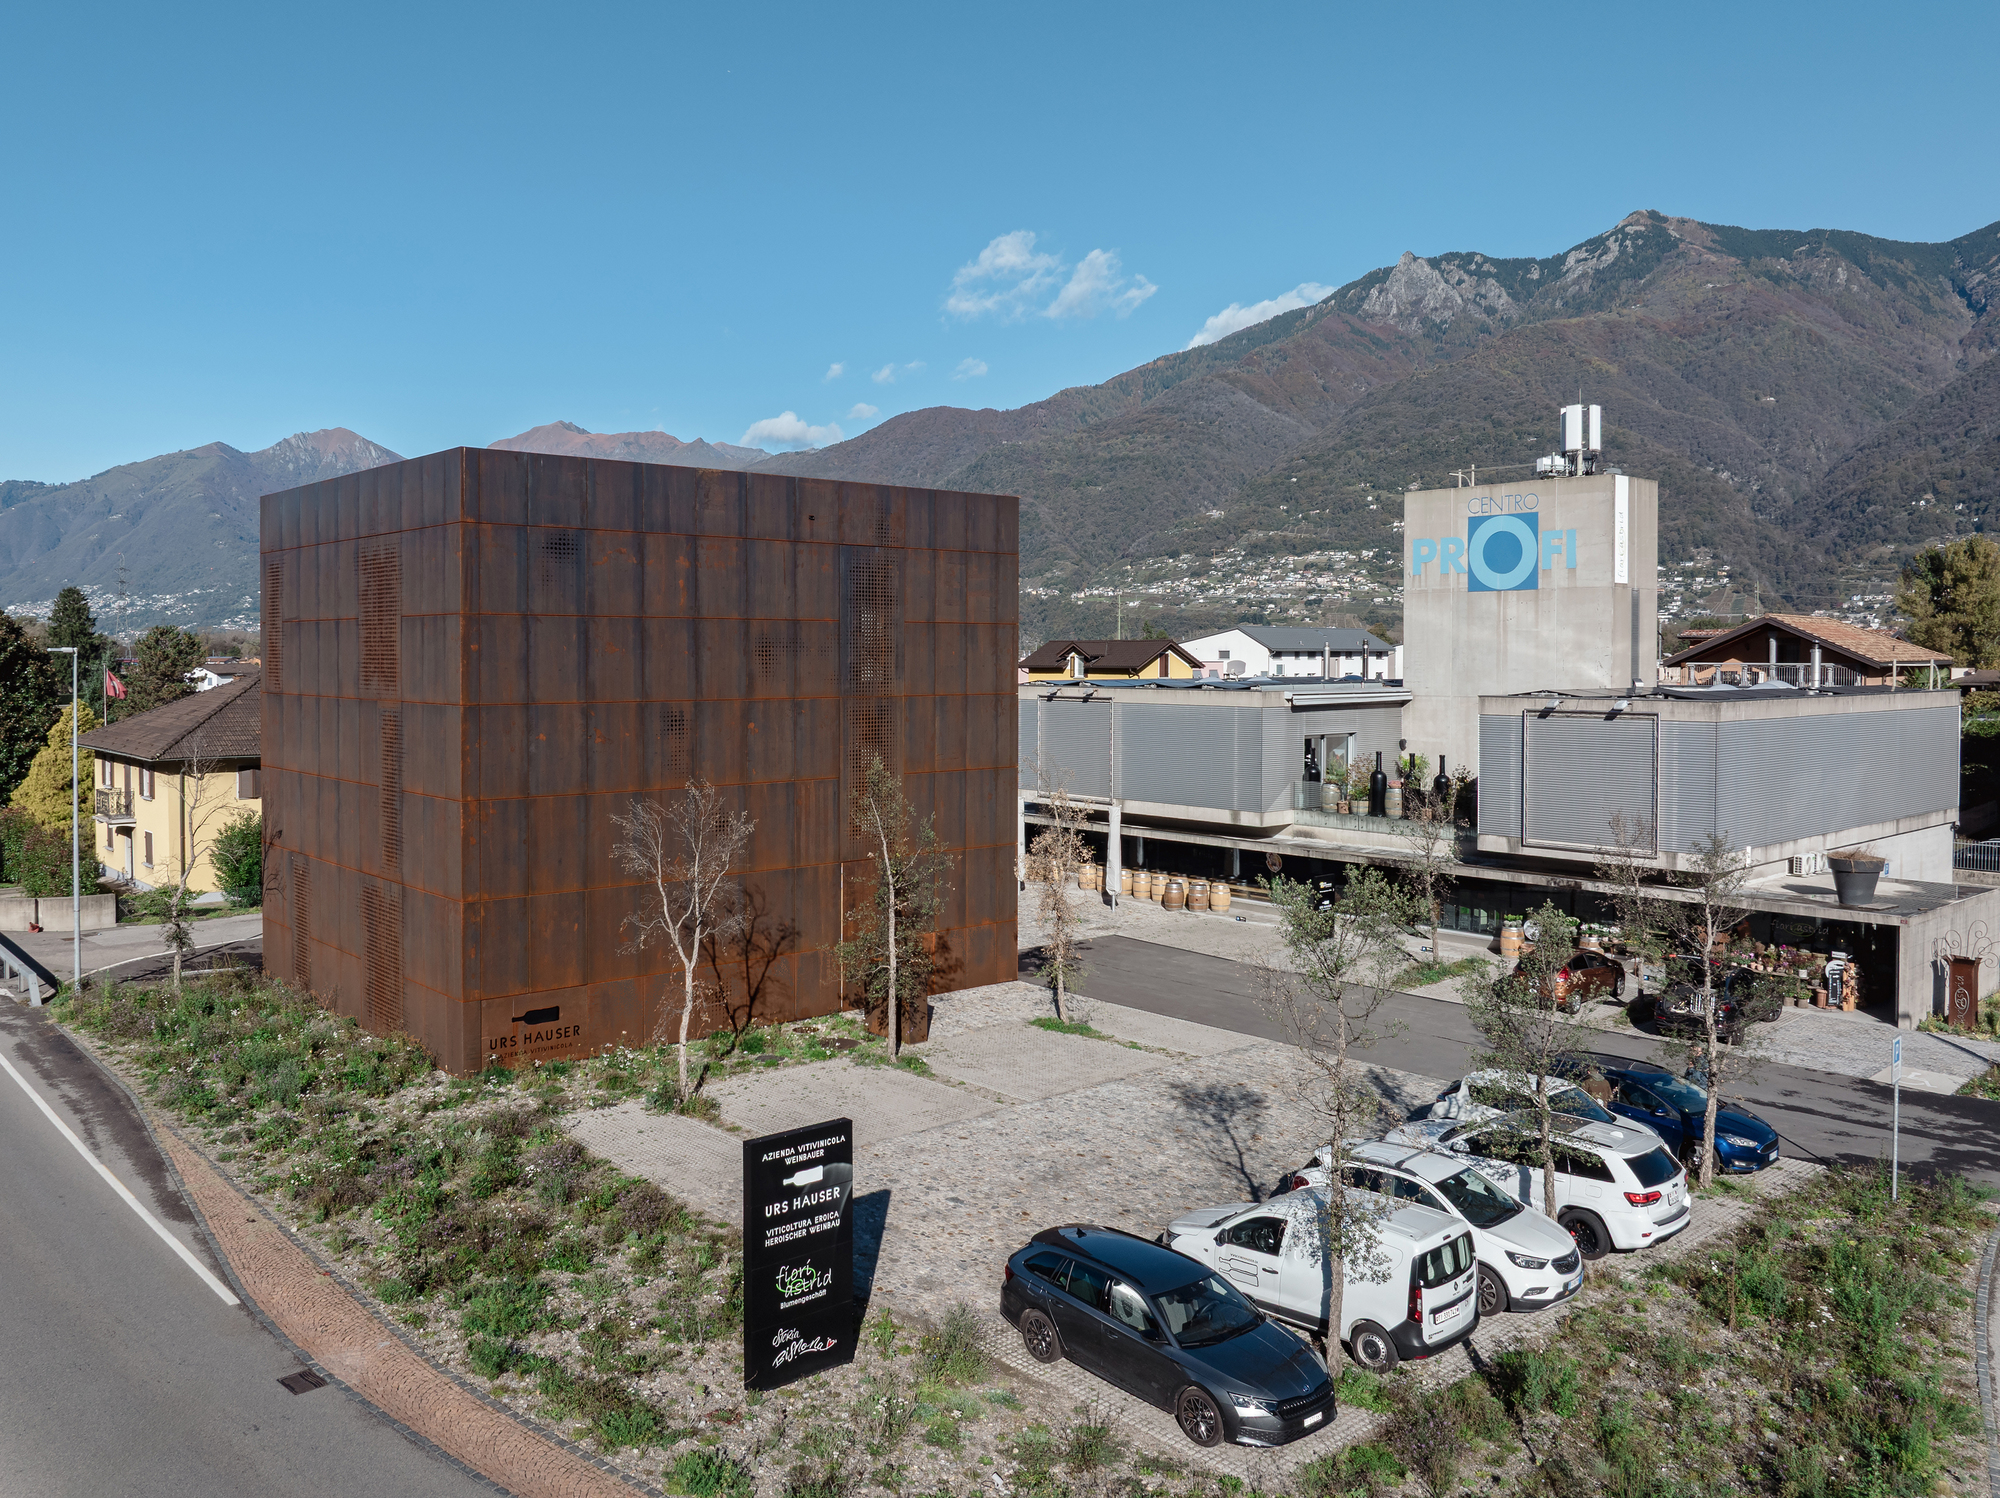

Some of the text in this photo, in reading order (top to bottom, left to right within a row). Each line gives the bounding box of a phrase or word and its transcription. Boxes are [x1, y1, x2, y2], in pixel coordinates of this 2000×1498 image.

[1468, 493, 1539, 515] CENTRO
[1412, 515, 1577, 590] PROFI
[489, 1025, 581, 1050] URS HAUSER
[500, 1042, 573, 1059] AZIENA VITIVINICOLA
[762, 1135, 846, 1162] AZIENDA VITIVINICOLA
[784, 1149, 825, 1165] WEINBAUER
[765, 1187, 840, 1217] URS HAUSER
[764, 1219, 841, 1247] HEROISCHER WEINBAU
[766, 1211, 840, 1237] VITICOLTURA EROICA
[775, 1259, 812, 1290] fiori
[784, 1268, 832, 1298] astrid
